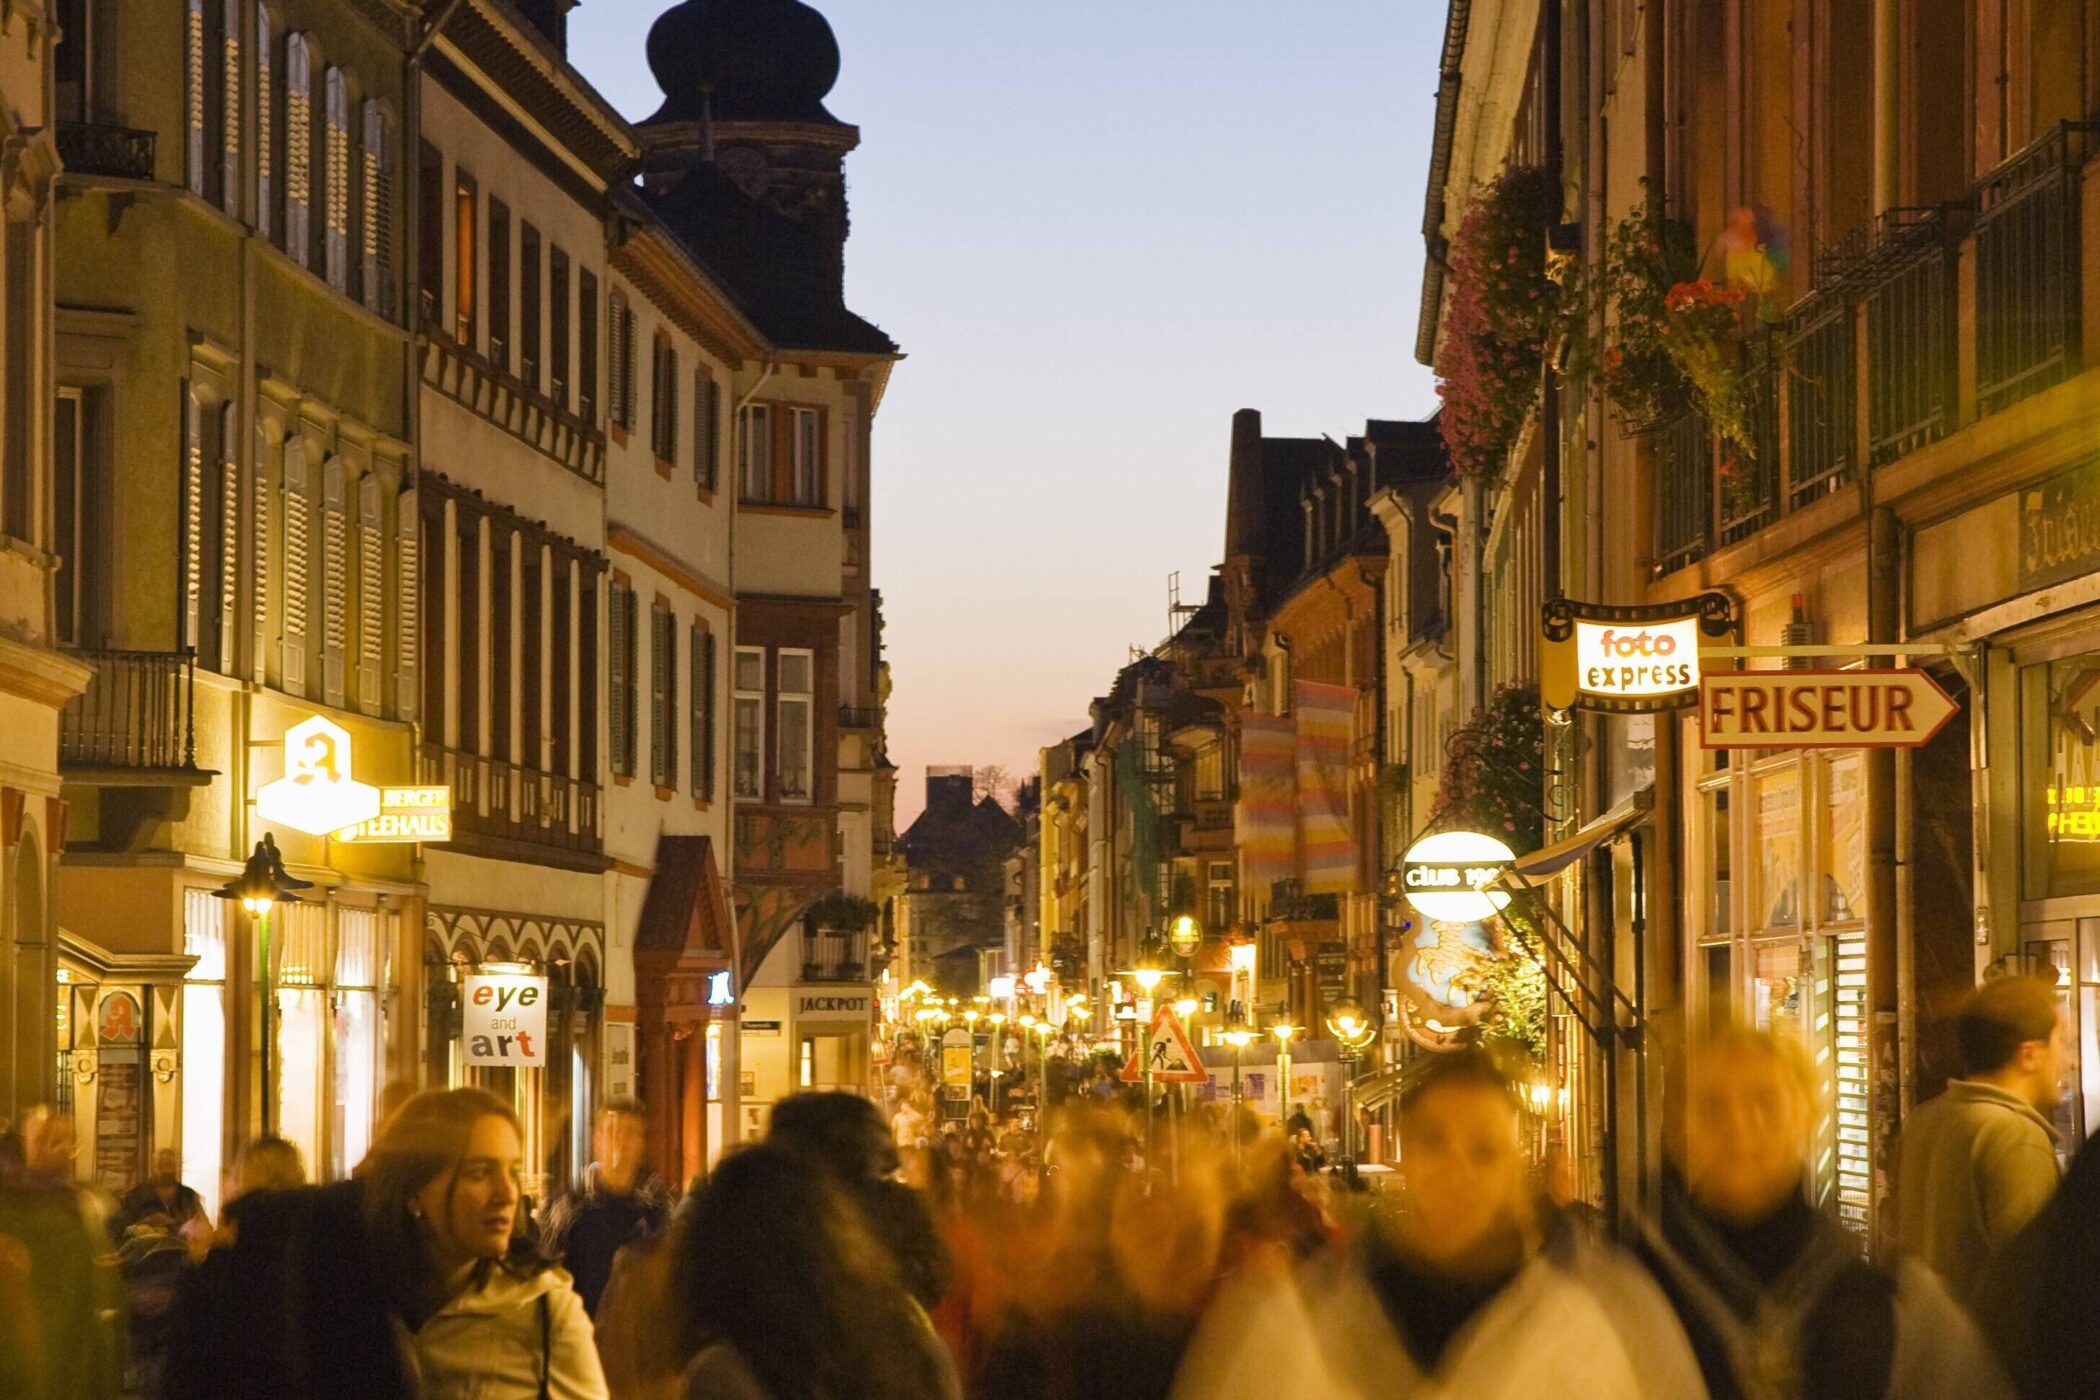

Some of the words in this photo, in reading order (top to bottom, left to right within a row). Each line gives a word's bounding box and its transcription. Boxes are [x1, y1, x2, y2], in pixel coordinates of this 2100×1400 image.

[1601, 629, 1676, 657] foto
[1587, 663, 1691, 691] express
[1709, 685, 1916, 734] FRISEUR
[380, 789, 448, 808] BERGER
[472, 985, 539, 1012] eye
[798, 997, 868, 1014] JACKPOT
[491, 1016, 517, 1030] and
[471, 1030, 535, 1057] art
